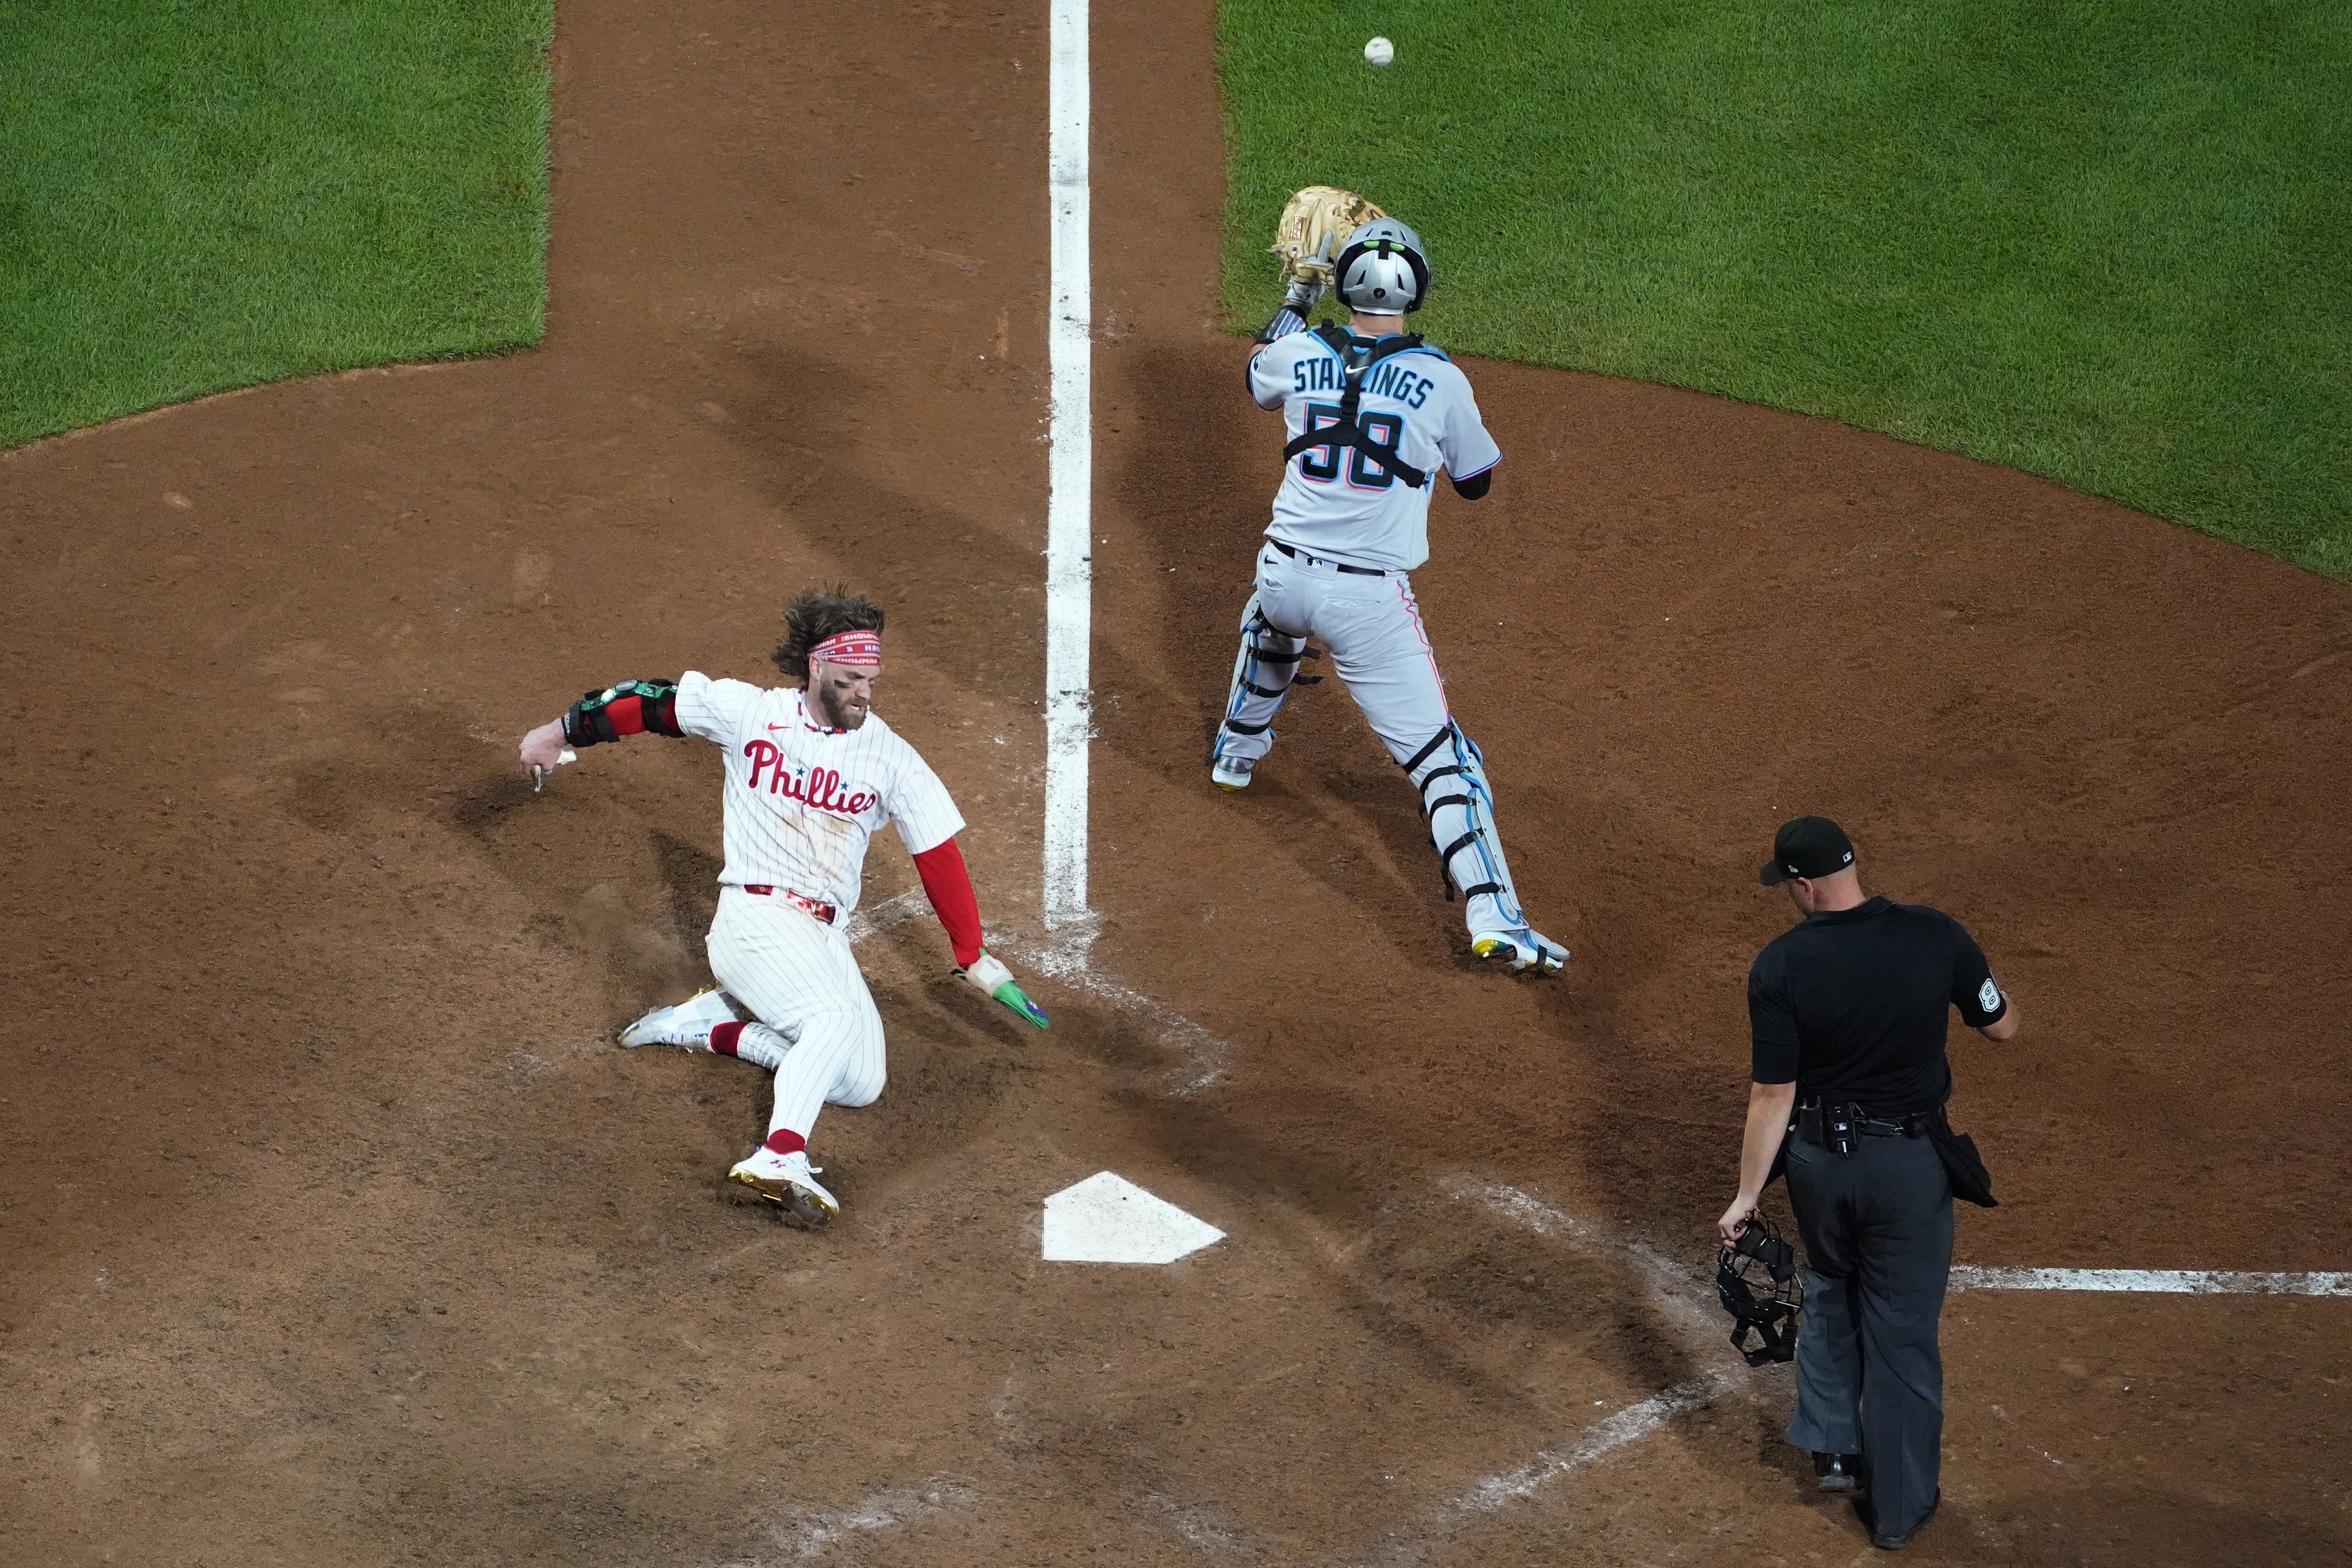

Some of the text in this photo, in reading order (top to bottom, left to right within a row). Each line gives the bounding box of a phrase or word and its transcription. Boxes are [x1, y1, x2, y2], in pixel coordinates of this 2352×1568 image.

[1294, 357, 1433, 409] STALINGS
[1299, 402, 1404, 492] 58
[744, 740, 876, 814] Phillies
[1979, 978, 2000, 1012] 8
